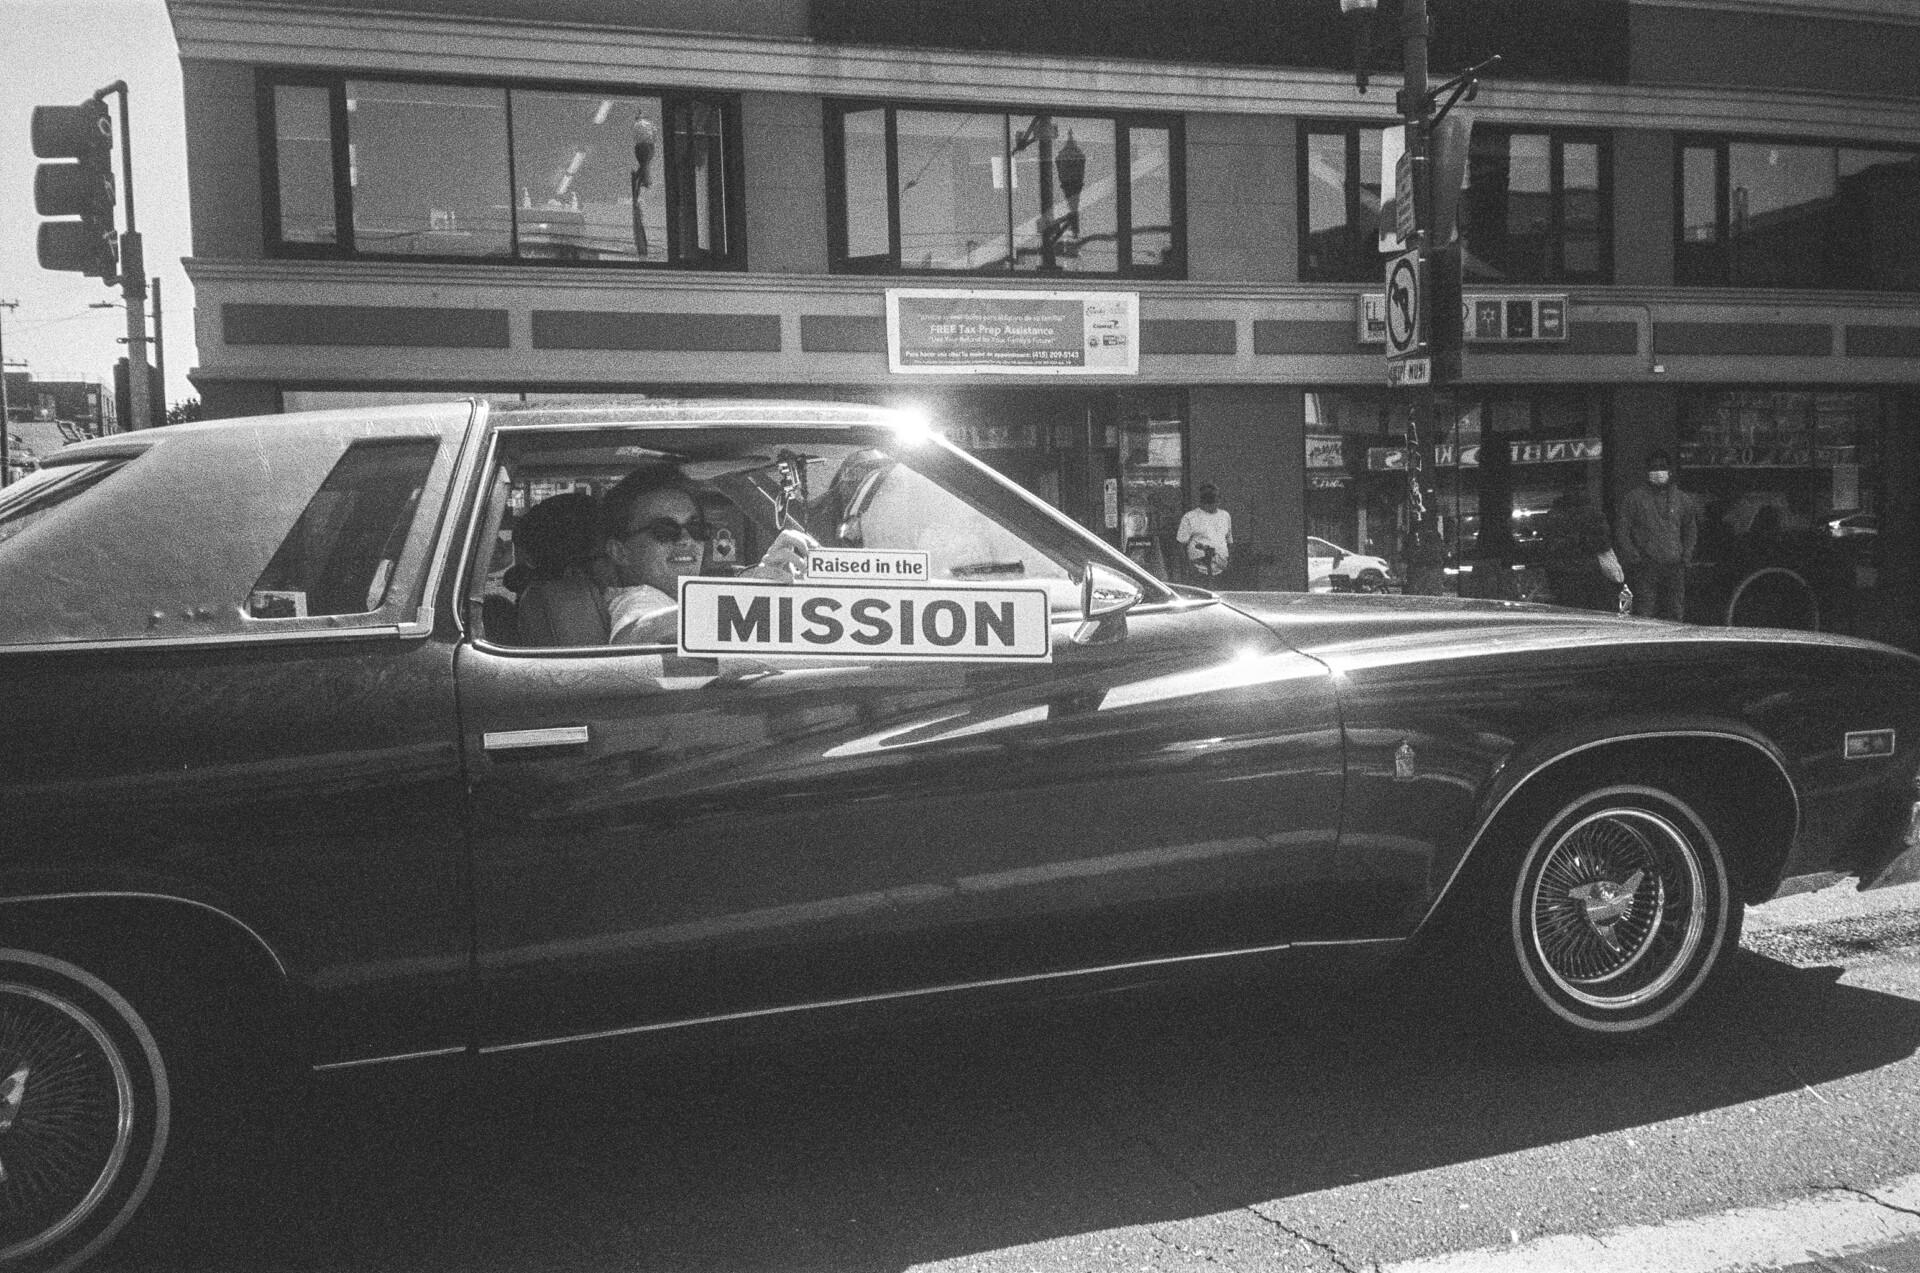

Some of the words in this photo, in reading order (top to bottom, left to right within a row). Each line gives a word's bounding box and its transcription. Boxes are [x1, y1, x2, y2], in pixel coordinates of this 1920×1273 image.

[930, 325, 957, 334] FREE
[959, 326, 976, 334] Tax
[979, 326, 1001, 336] Prep
[1003, 326, 1054, 335] Assistance
[905, 350, 919, 358] Para
[1032, 350, 1047, 359] (415)
[1050, 350, 1080, 359] 209-5143
[811, 557, 871, 574] Raised
[875, 559, 890, 574] in
[895, 559, 923, 575] the
[717, 595, 1016, 647] MISSION
